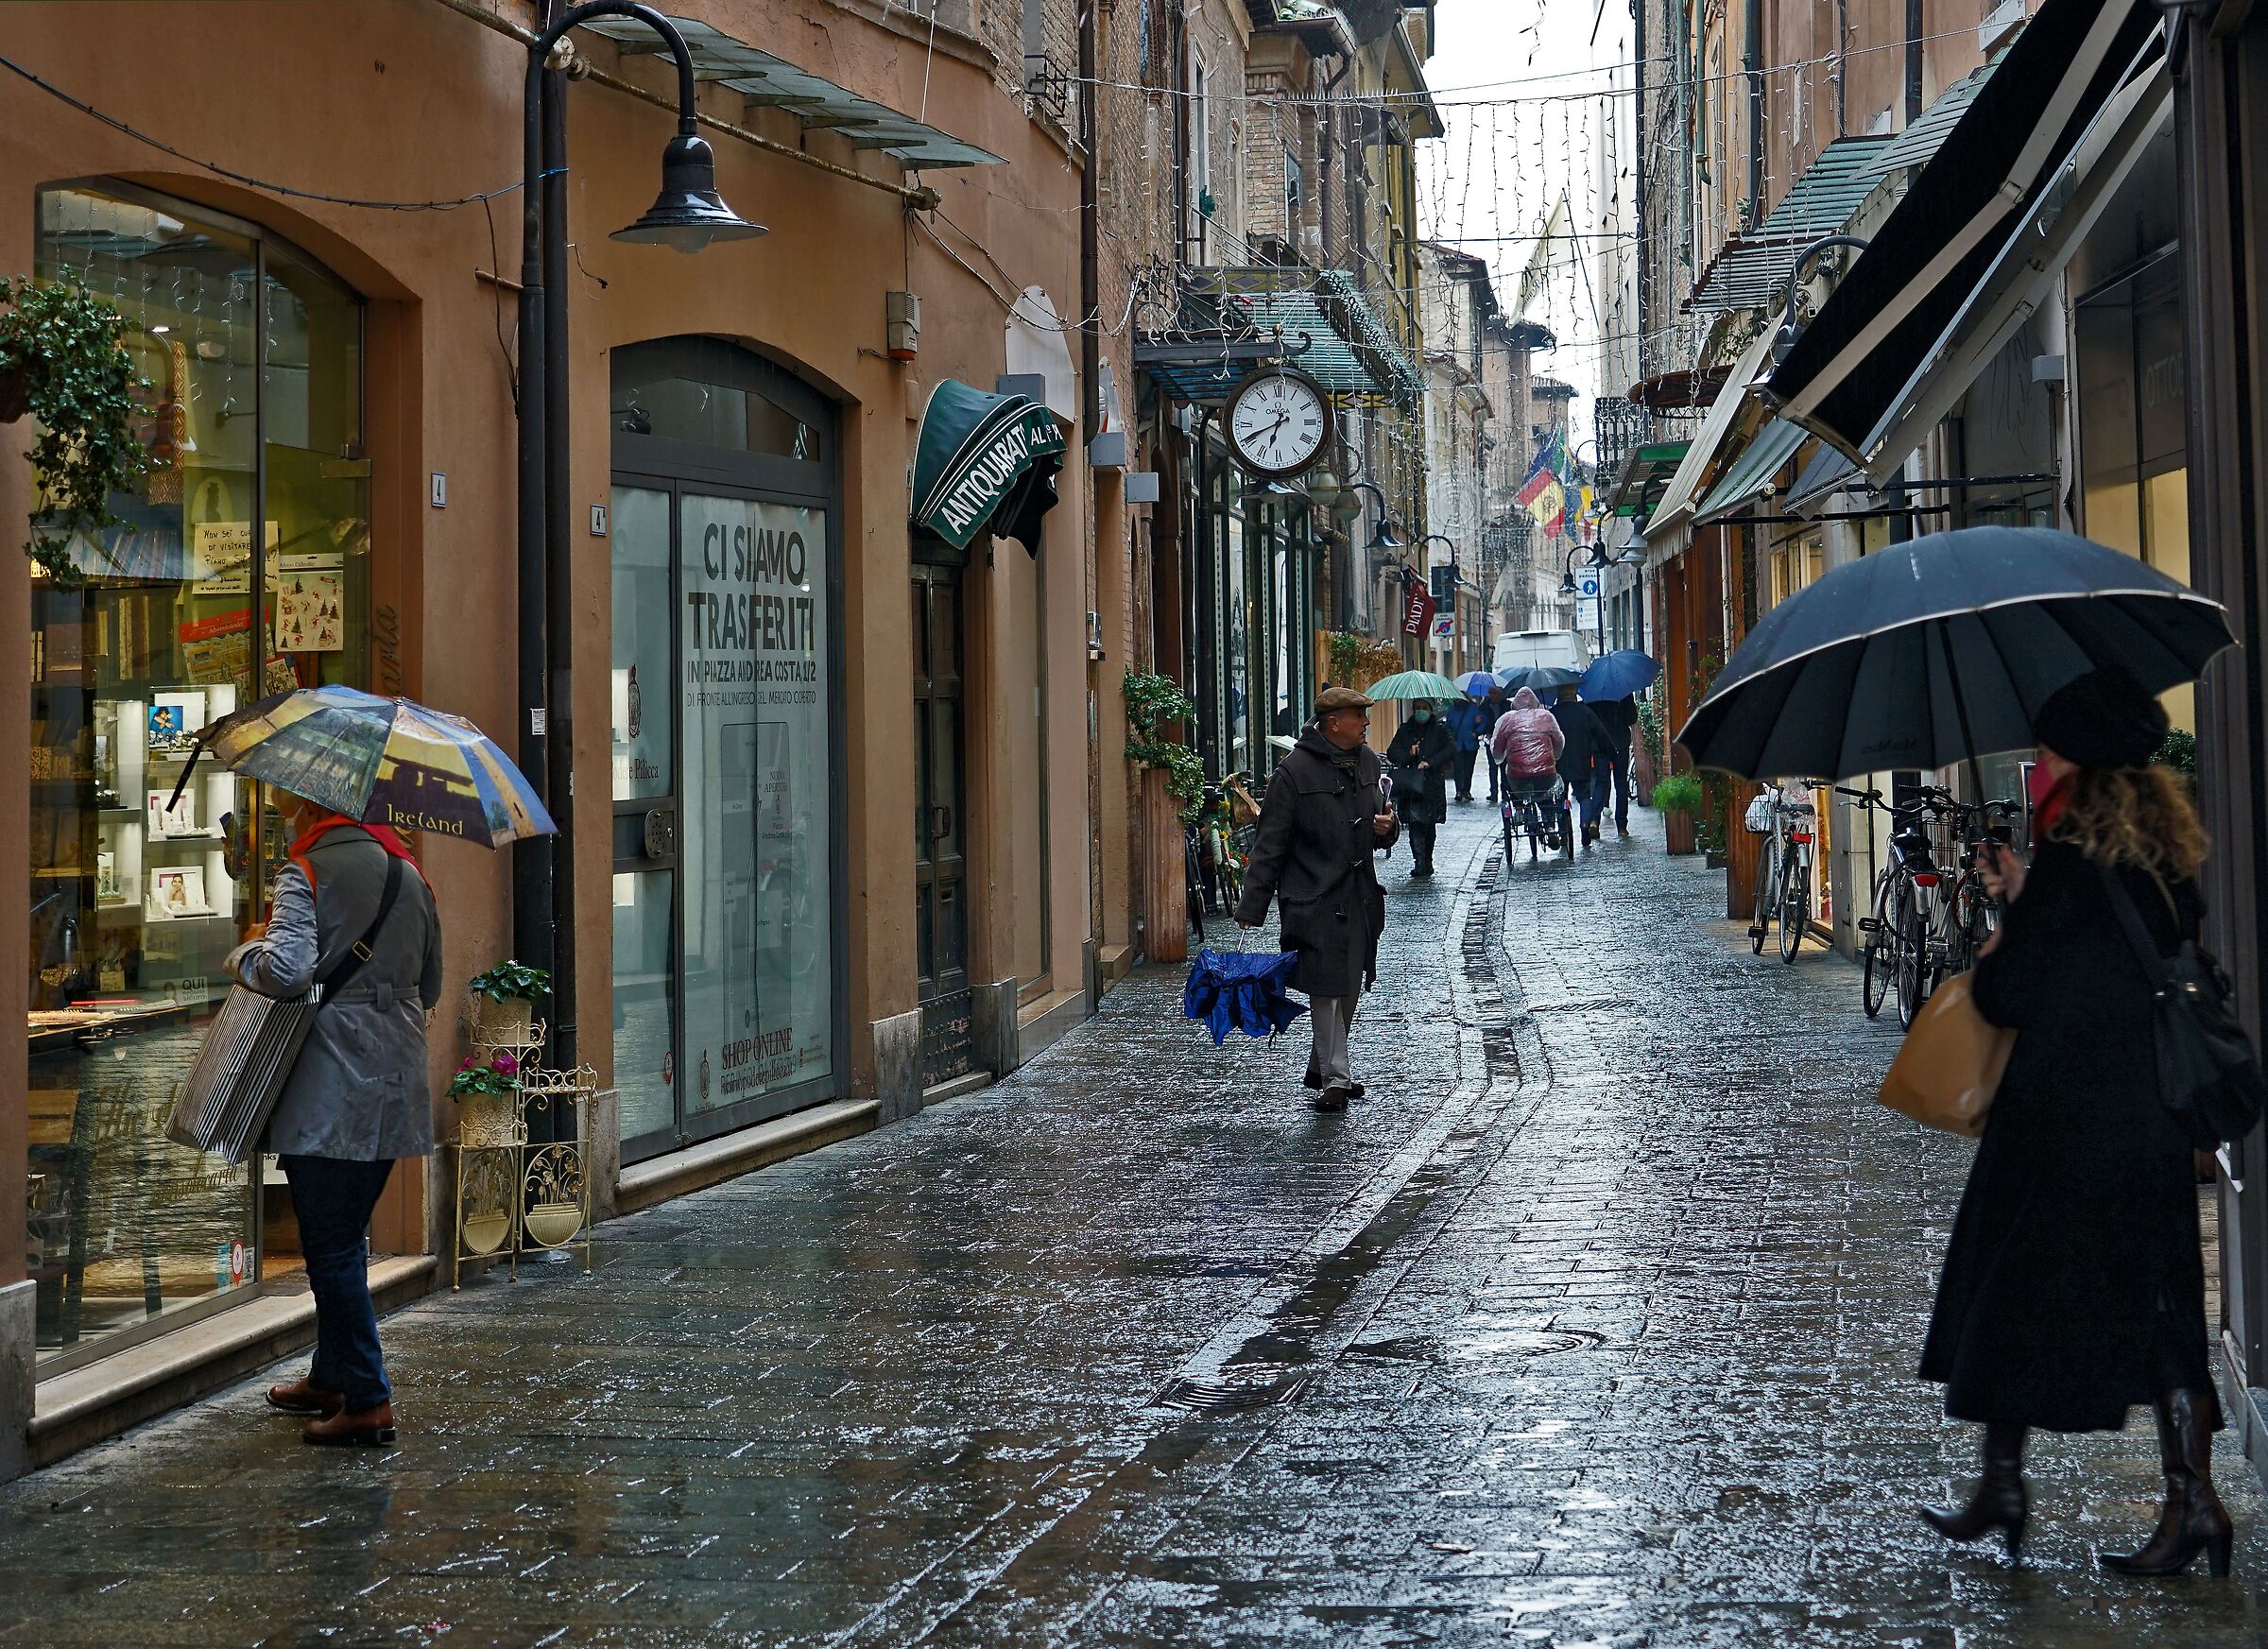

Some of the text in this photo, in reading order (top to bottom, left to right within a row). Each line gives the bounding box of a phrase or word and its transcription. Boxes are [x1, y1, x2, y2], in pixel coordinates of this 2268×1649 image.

[1030, 426, 1047, 446] AL
[704, 523, 806, 586] CI SIAMO
[688, 593, 815, 650] TRASFERITI
[687, 661, 700, 682] IN
[704, 661, 736, 682] PIAZZA
[737, 661, 773, 681] ANDREA
[687, 693, 695, 707] DI
[697, 692, 720, 707] FRONTE
[769, 690, 793, 704] MERCATO
[794, 690, 816, 704] COPERTO
[634, 758, 659, 781] Pilicca
[387, 804, 462, 835] Ireland
[182, 979, 205, 990] QUI
[722, 1039, 751, 1070] SHOP
[753, 1027, 793, 1060] ONLINE
